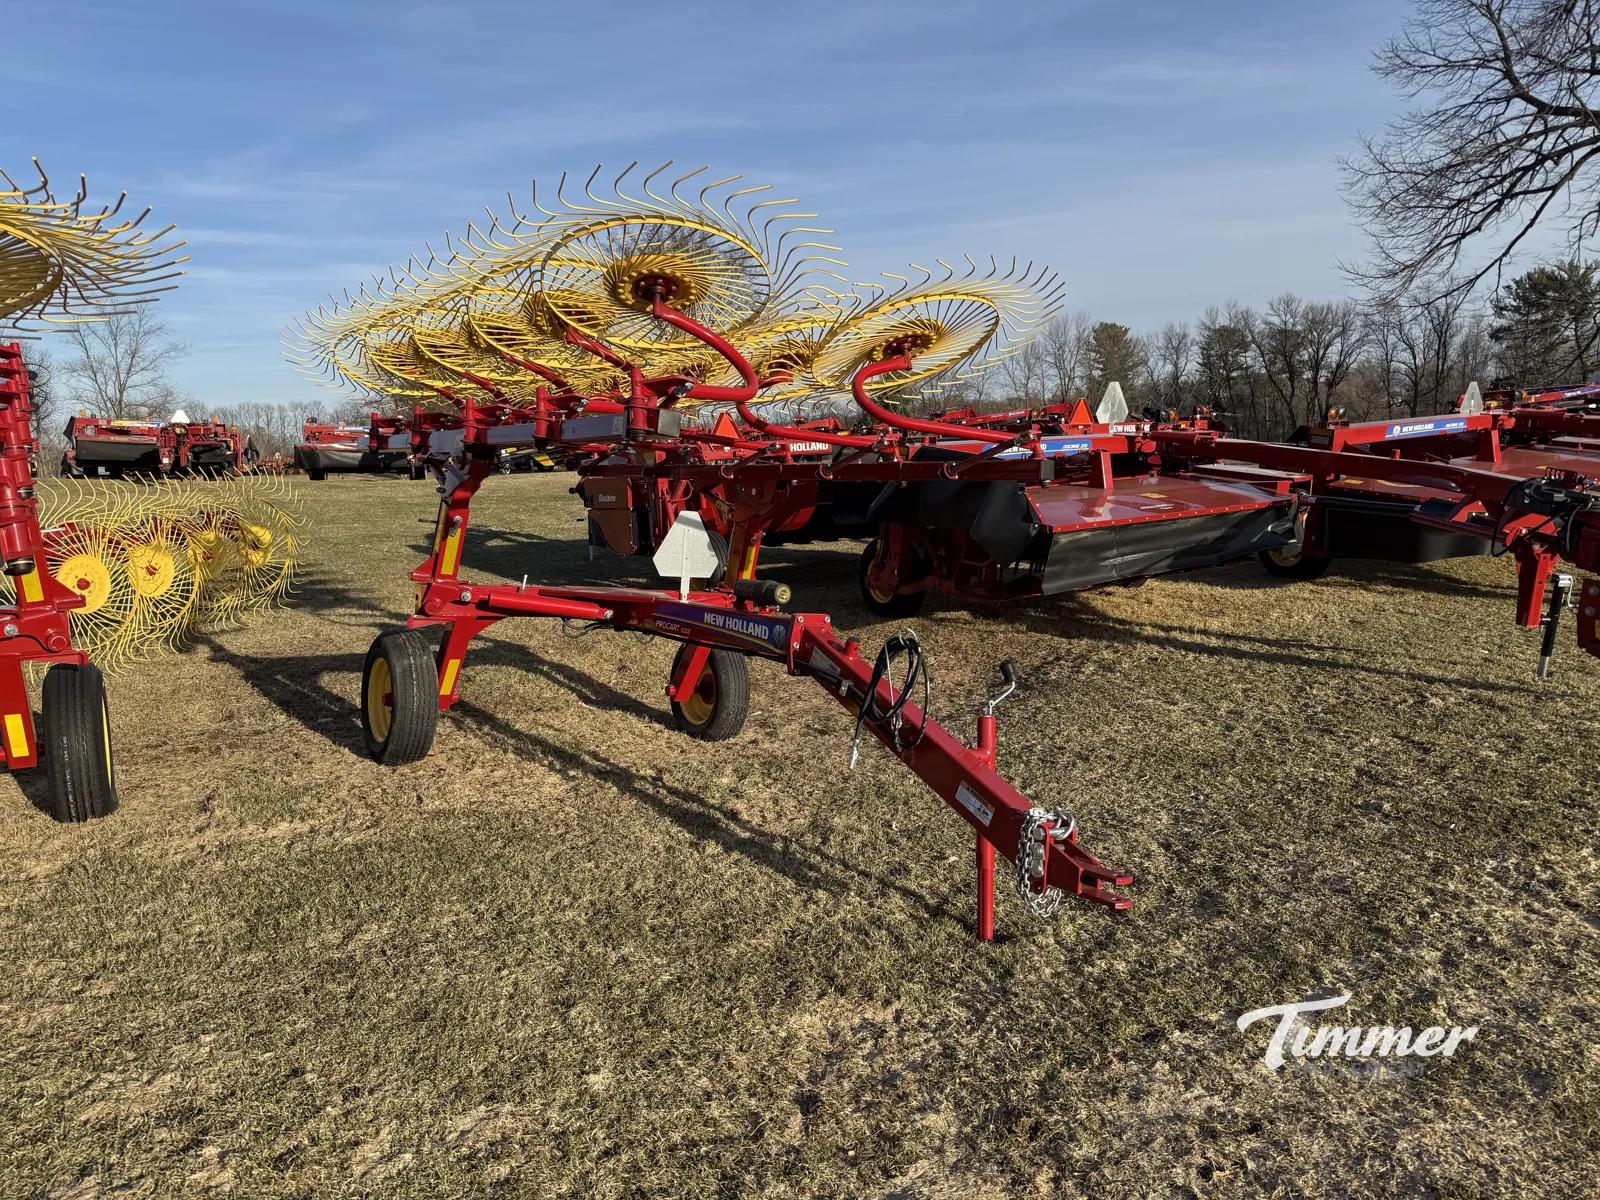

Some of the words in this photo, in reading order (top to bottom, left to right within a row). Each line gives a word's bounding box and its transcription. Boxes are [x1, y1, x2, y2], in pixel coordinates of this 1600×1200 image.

[1402, 425, 1413, 433] NEW
[1413, 422, 1435, 431] HOLLAND
[790, 442, 829, 452] HOLLAND
[598, 494, 616, 502] Discbine
[656, 619, 680, 632] PROCART
[704, 612, 724, 627] NEW
[725, 617, 769, 640] HOLLAND
